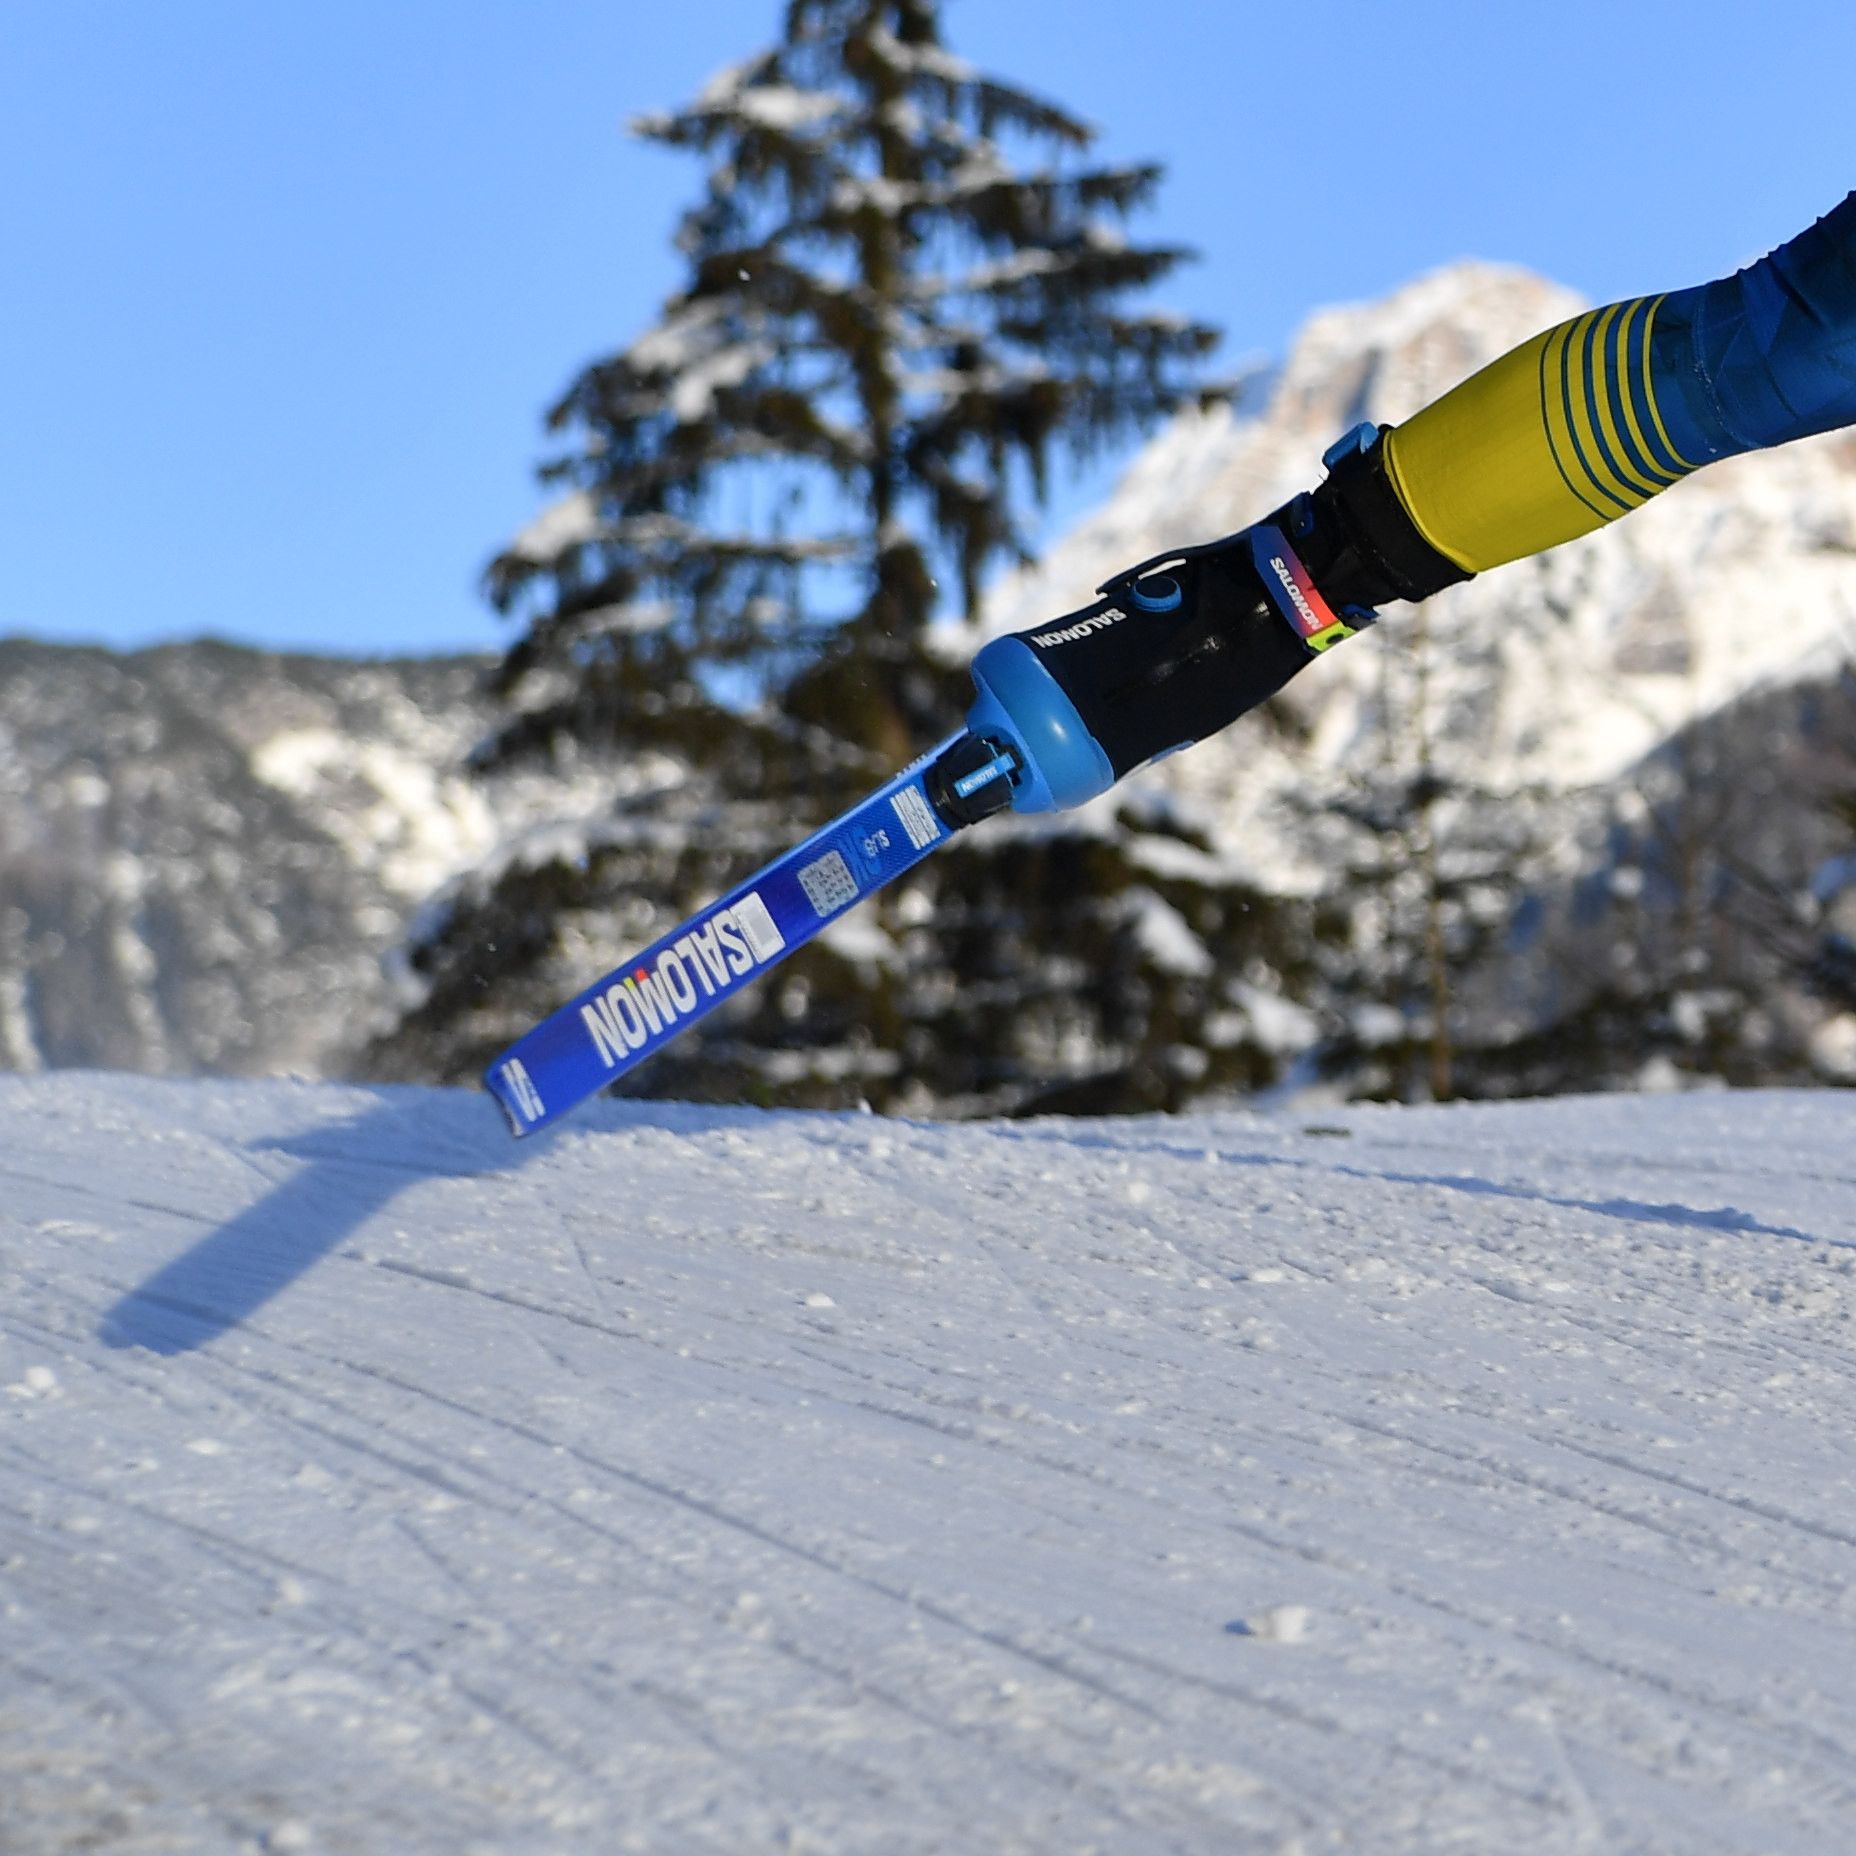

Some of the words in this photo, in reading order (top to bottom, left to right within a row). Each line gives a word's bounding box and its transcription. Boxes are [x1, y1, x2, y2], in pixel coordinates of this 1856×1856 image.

[1030, 607, 1128, 650] SALOMON
[1269, 556, 1323, 630] SALOMON
[579, 908, 755, 1069] SALOMON
